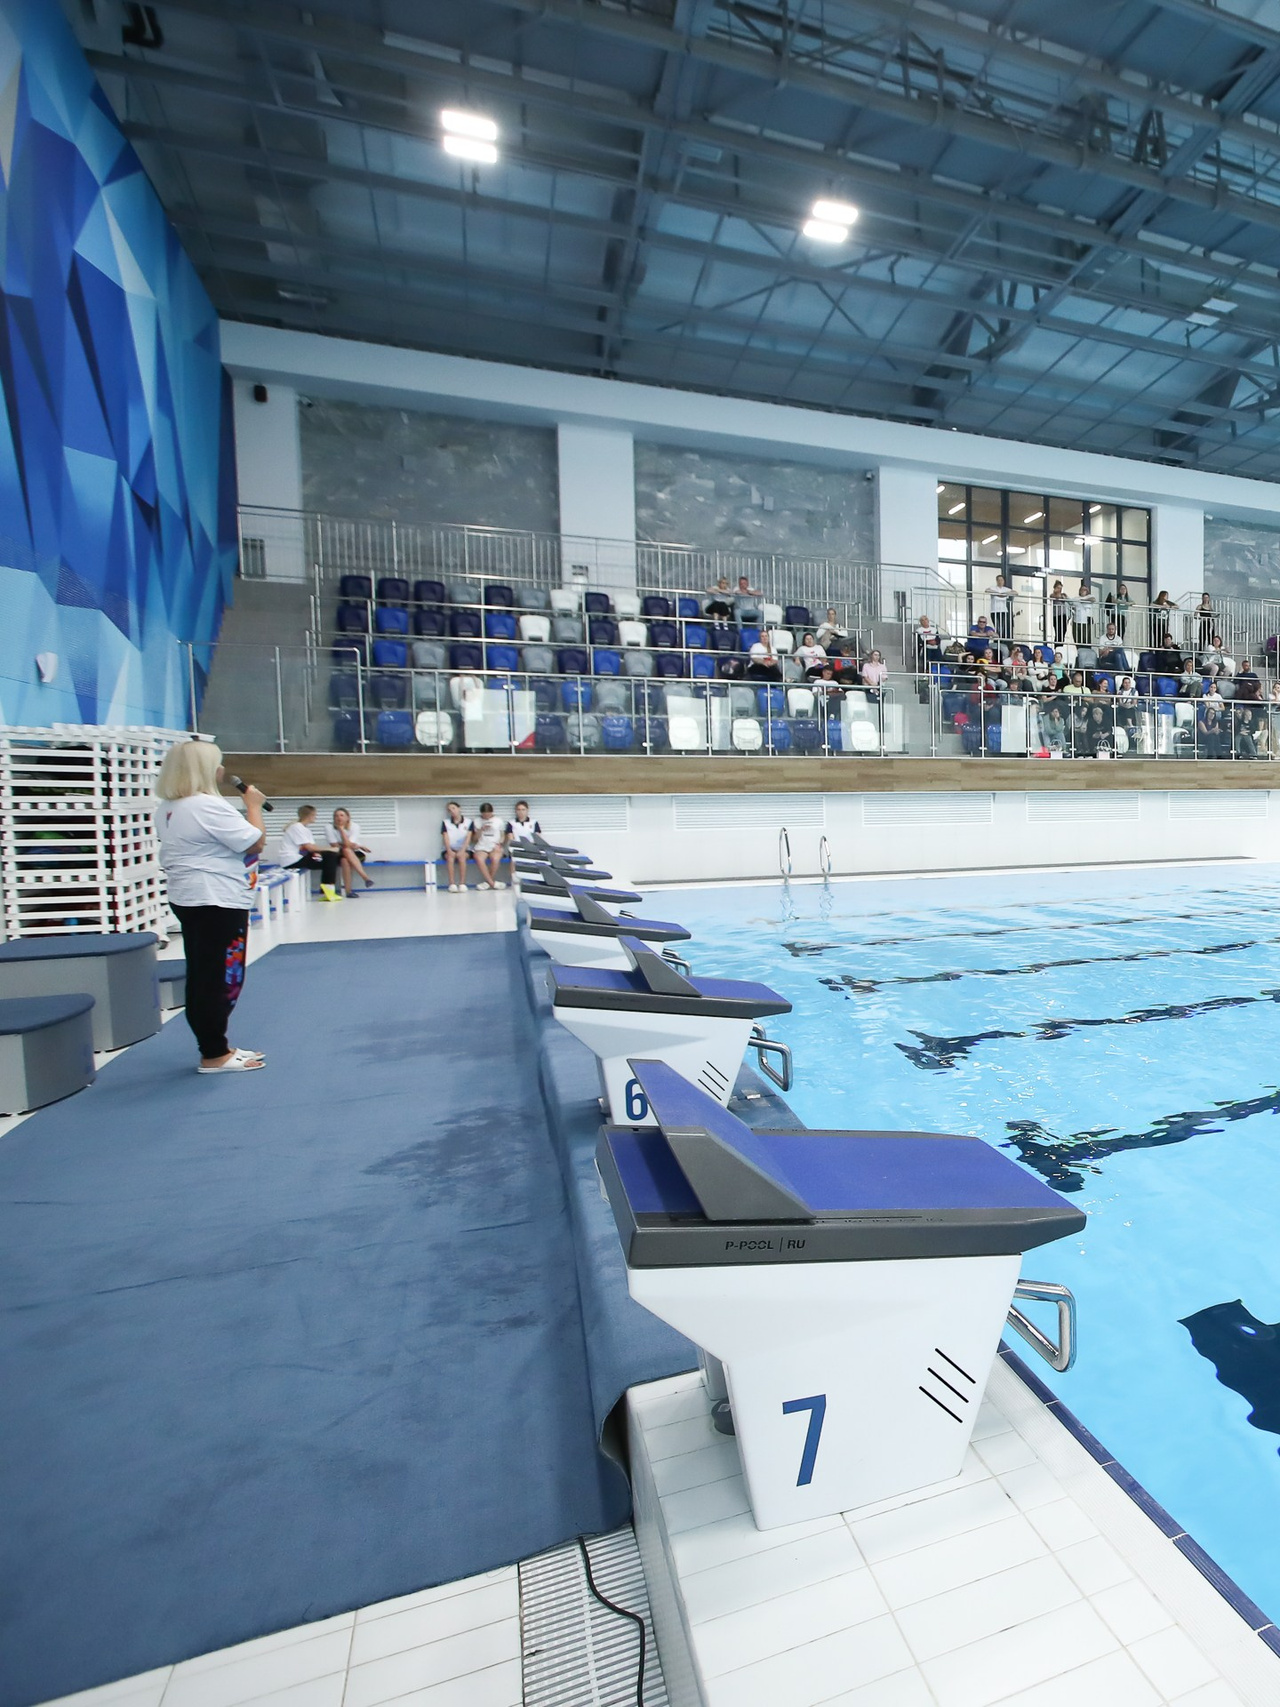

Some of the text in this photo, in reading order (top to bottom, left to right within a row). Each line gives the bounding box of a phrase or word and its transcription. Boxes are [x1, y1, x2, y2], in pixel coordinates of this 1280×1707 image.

[625, 1078, 648, 1121] 6
[725, 1239, 806, 1251] P-POOL RU
[782, 1393, 827, 1487] 7
